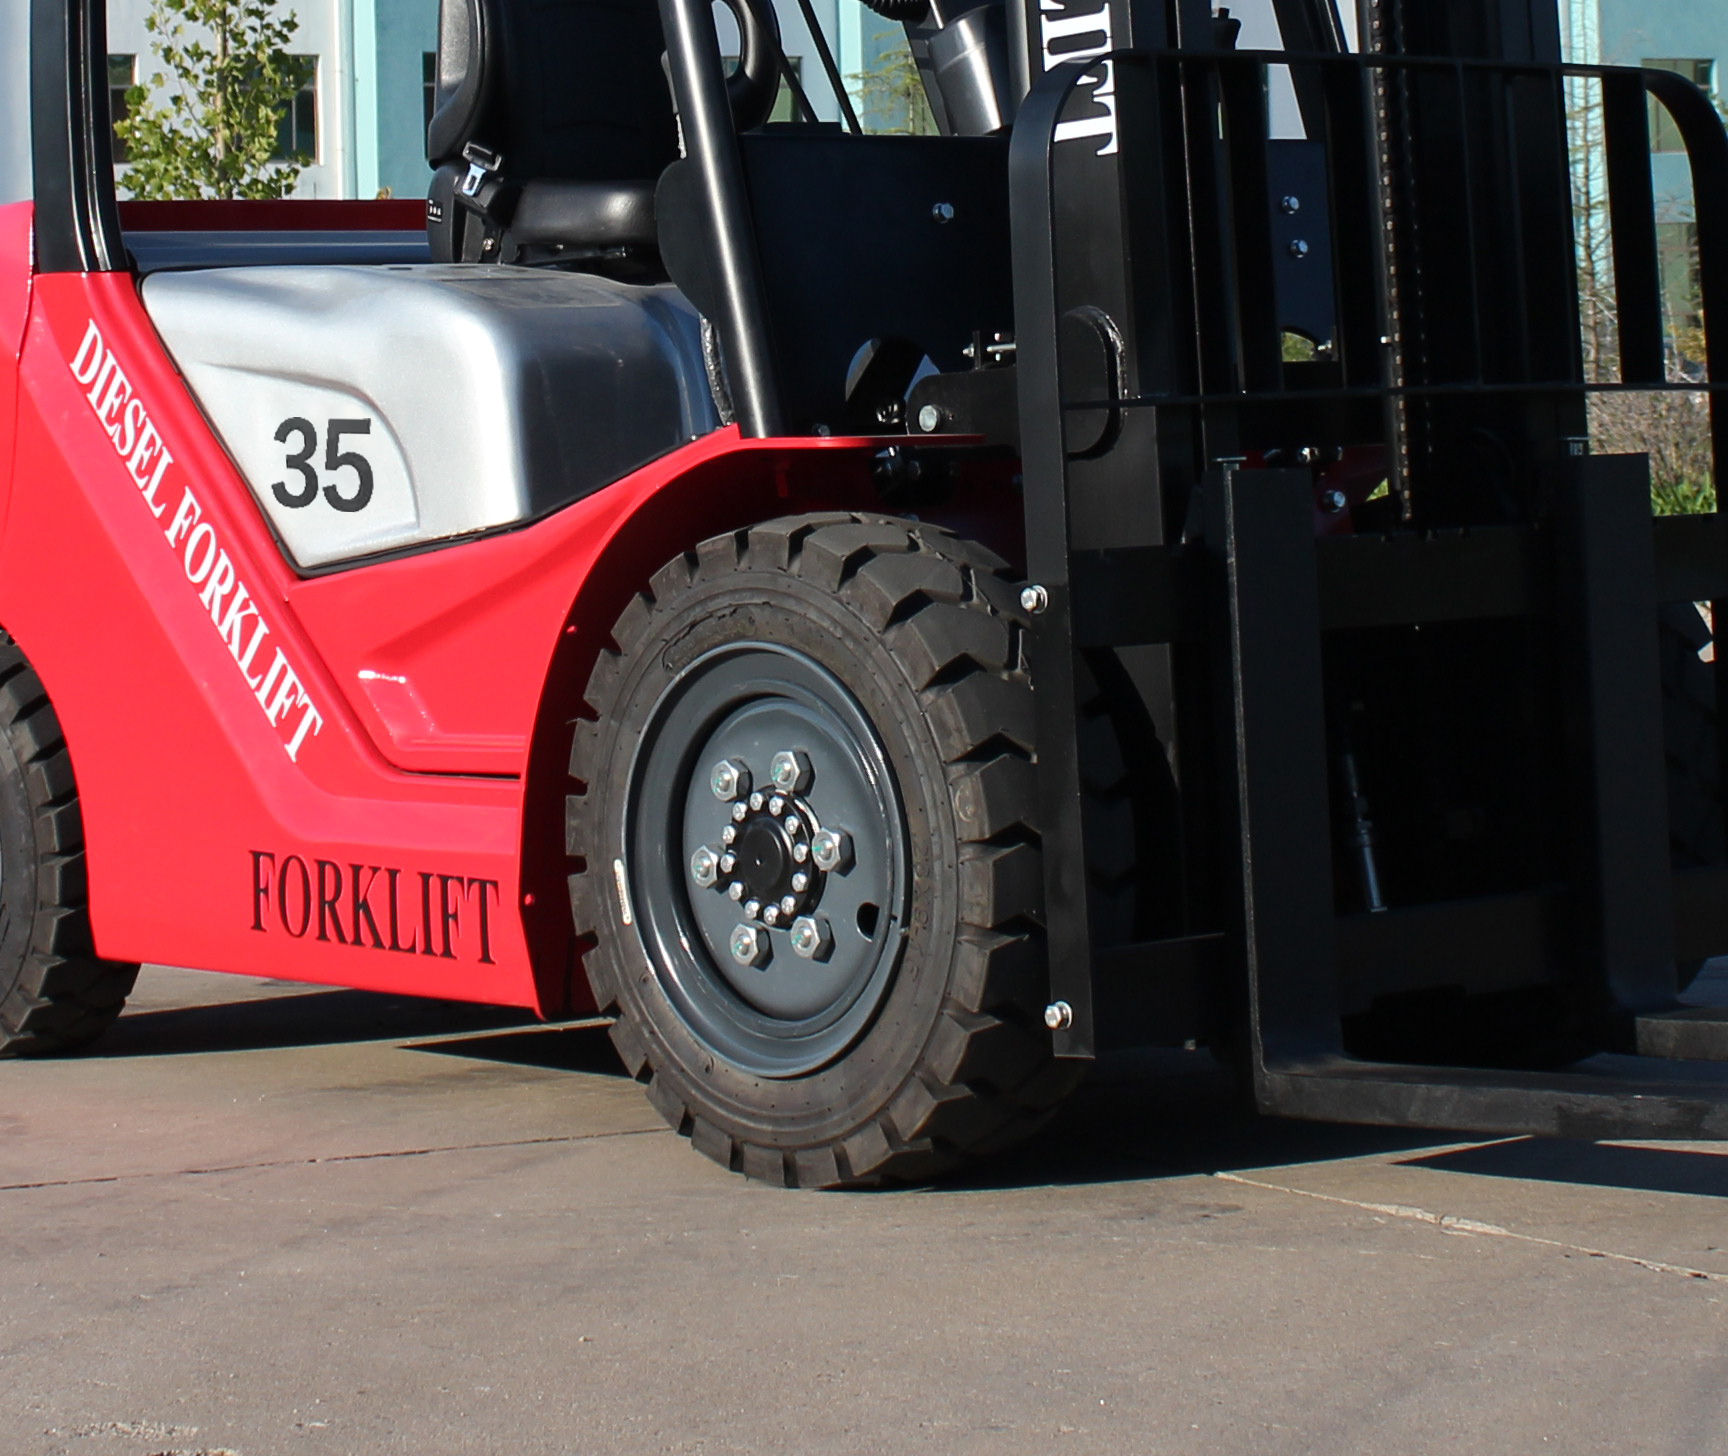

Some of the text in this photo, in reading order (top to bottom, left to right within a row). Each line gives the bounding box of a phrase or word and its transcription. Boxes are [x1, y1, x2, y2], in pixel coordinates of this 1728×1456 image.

[271, 416, 374, 513] 35
[70, 317, 324, 763] DIESEL FORKLIFT
[248, 849, 500, 965] FORKLIFT
